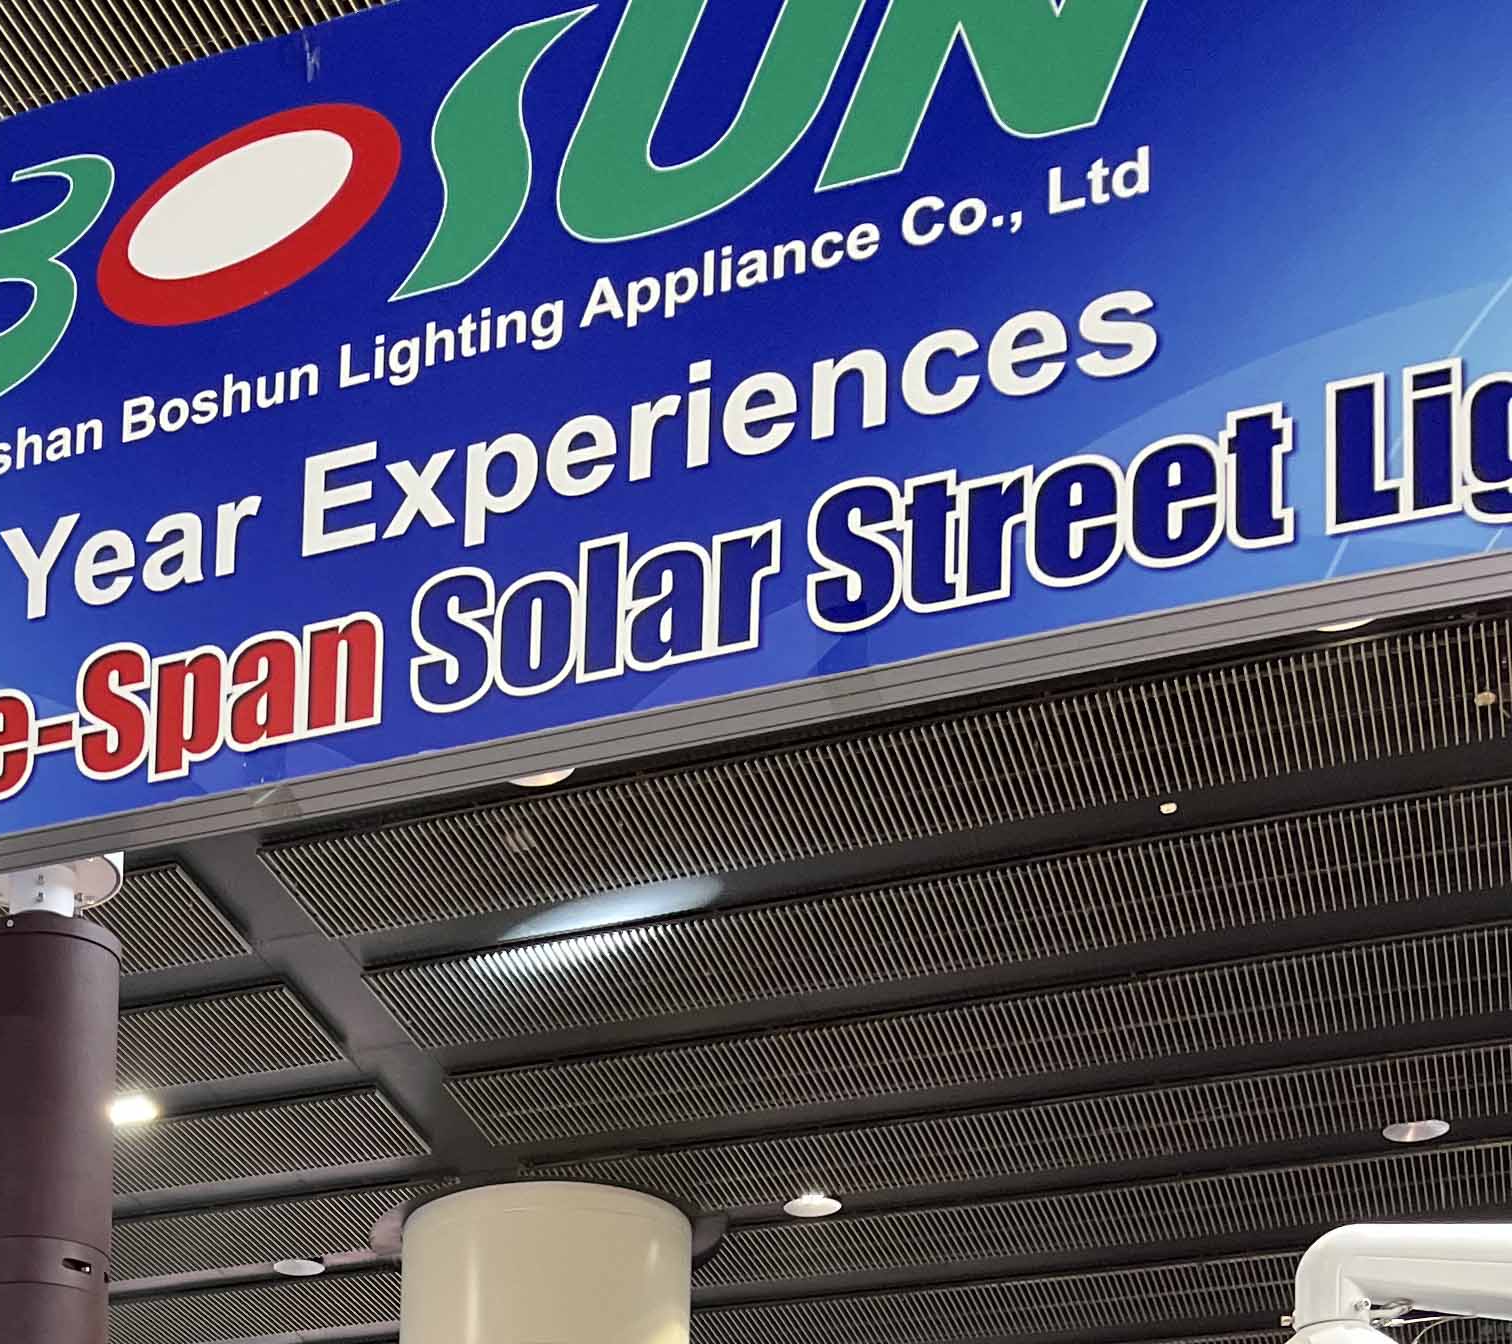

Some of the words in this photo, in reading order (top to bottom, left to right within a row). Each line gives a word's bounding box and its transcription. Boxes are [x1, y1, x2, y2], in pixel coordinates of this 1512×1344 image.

[122, 359, 319, 442] Boshun
[337, 301, 566, 390] Lighting
[579, 219, 881, 329] Appliance
[900, 189, 1022, 248] Co.,
[1046, 147, 1150, 215] Ltd
[0, 492, 262, 622] Year
[300, 288, 1160, 559] Experiences
[410, 518, 781, 713] Solar
[807, 401, 1293, 634] Street
